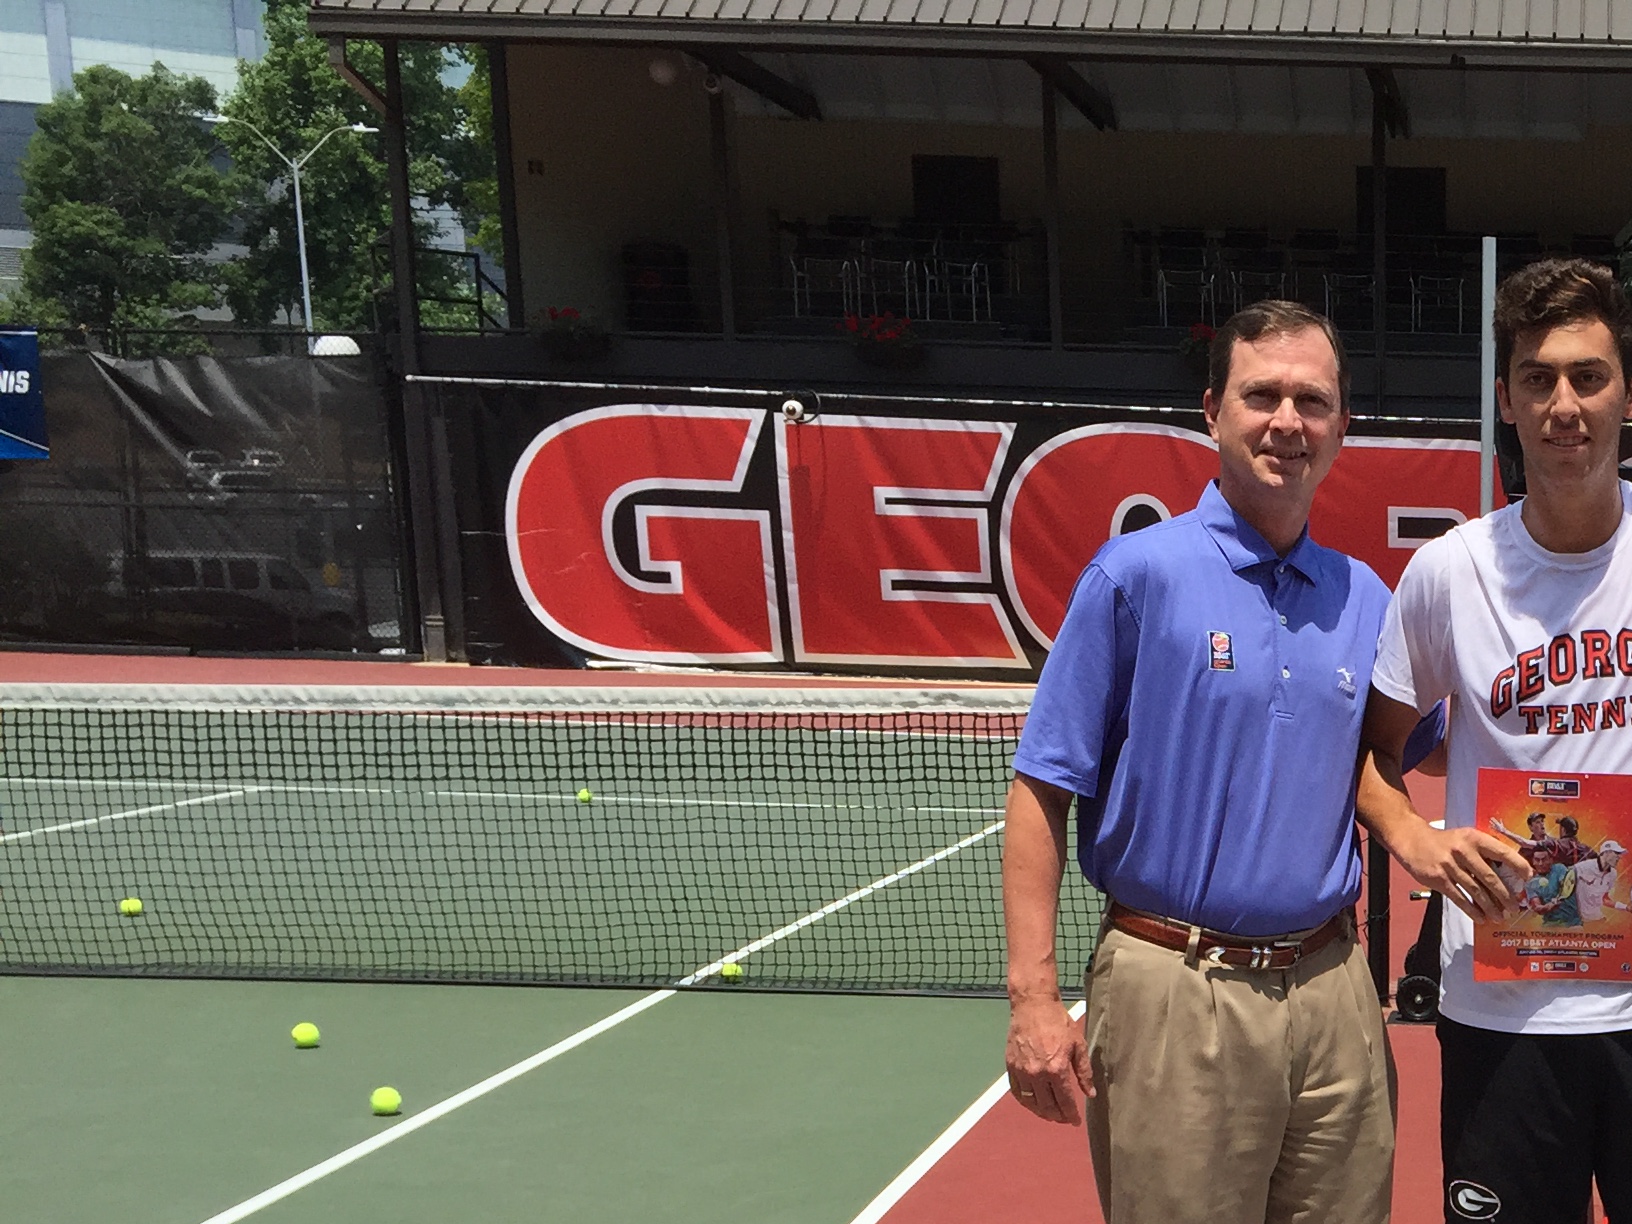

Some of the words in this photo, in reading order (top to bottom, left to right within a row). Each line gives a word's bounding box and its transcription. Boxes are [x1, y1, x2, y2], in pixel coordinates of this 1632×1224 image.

[1585, 933, 1625, 941] PROGRAM
[1501, 939, 1521, 947] 2017
[1548, 939, 1588, 948] ATLANTA
[1591, 940, 1616, 949] OPEN
